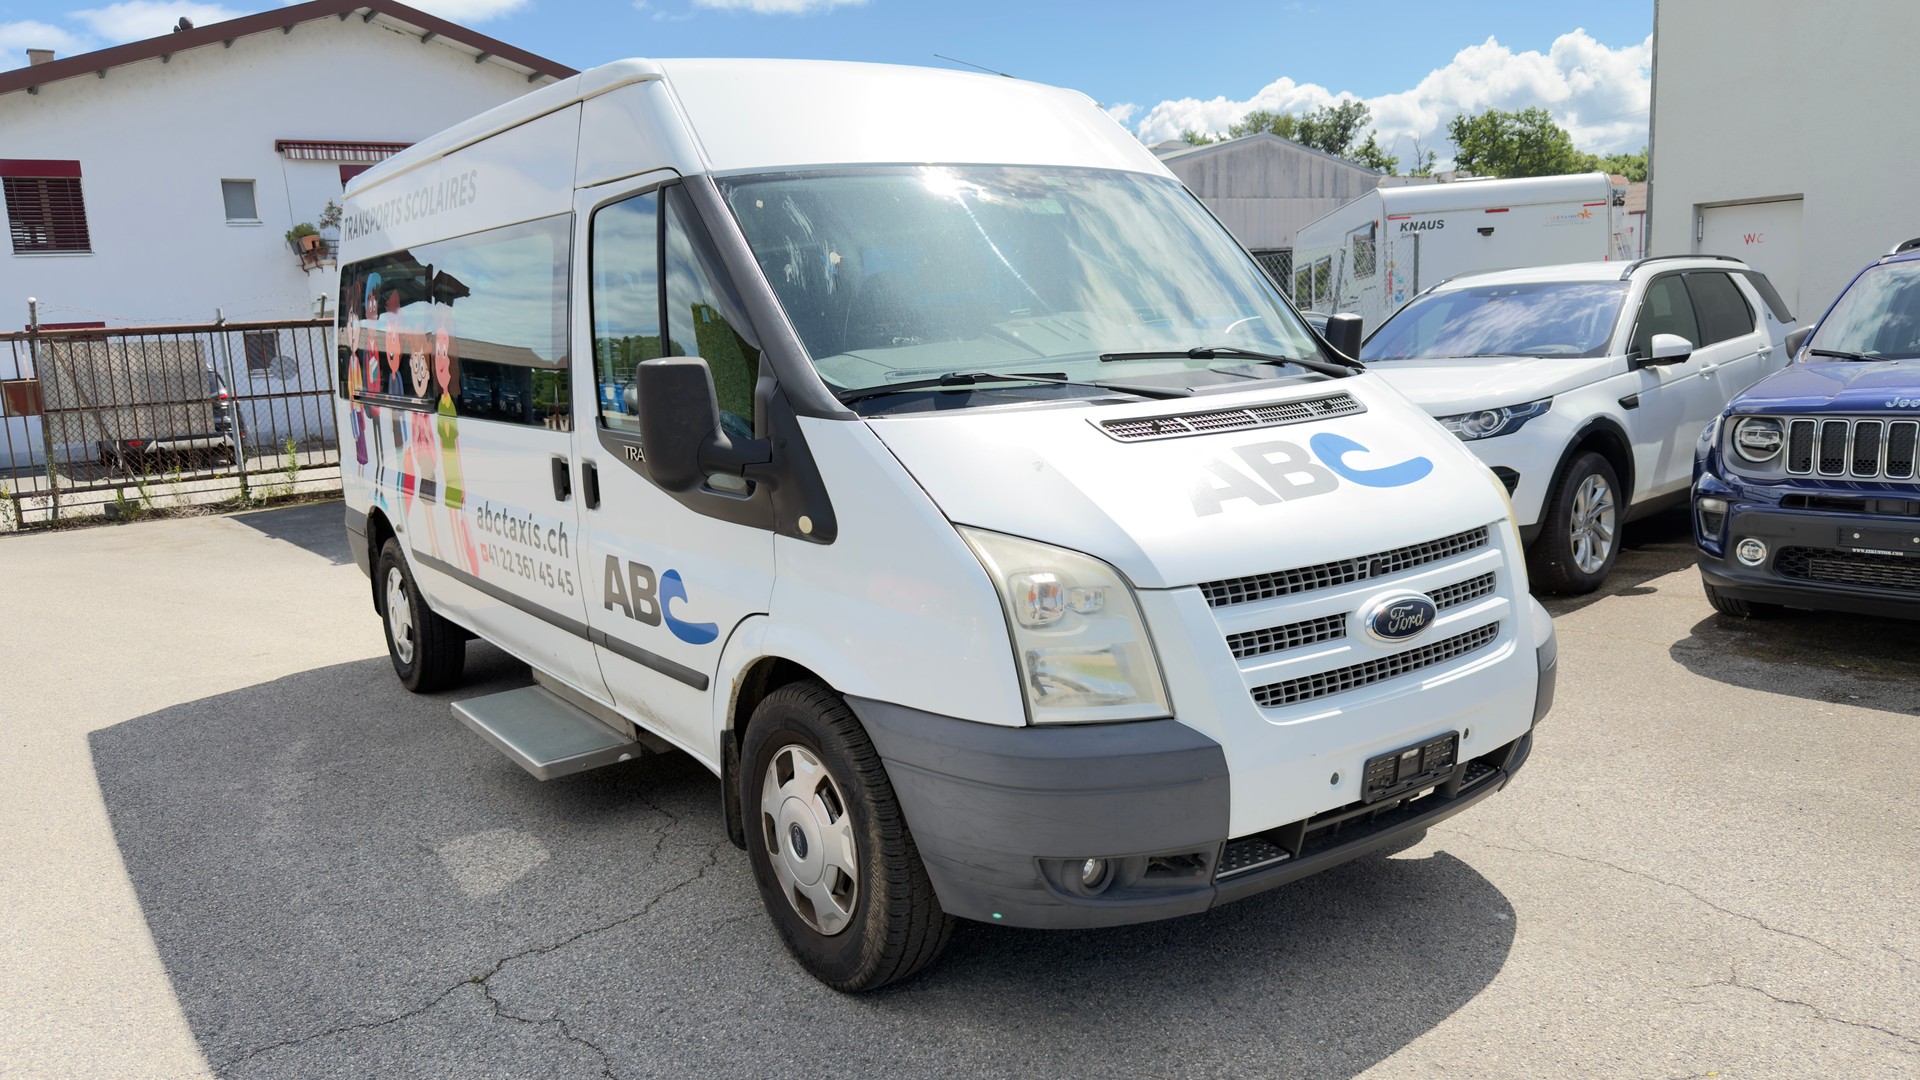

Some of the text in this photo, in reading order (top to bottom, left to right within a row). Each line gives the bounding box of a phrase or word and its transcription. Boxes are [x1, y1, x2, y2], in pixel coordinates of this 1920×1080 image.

[344, 169, 478, 242] TRANSPORTS SCOLAIRES
[1400, 219, 1445, 232] KNAUS
[1743, 233, 1765, 245] WC
[1186, 432, 1434, 518] ABC
[477, 500, 569, 559] abctaxis.ch
[500, 547, 515, 574] 22
[515, 552, 537, 582] 361
[539, 561, 555, 589] 45
[557, 567, 574, 597] 45
[604, 554, 719, 645] ABC
[1388, 604, 1426, 634] Ford
